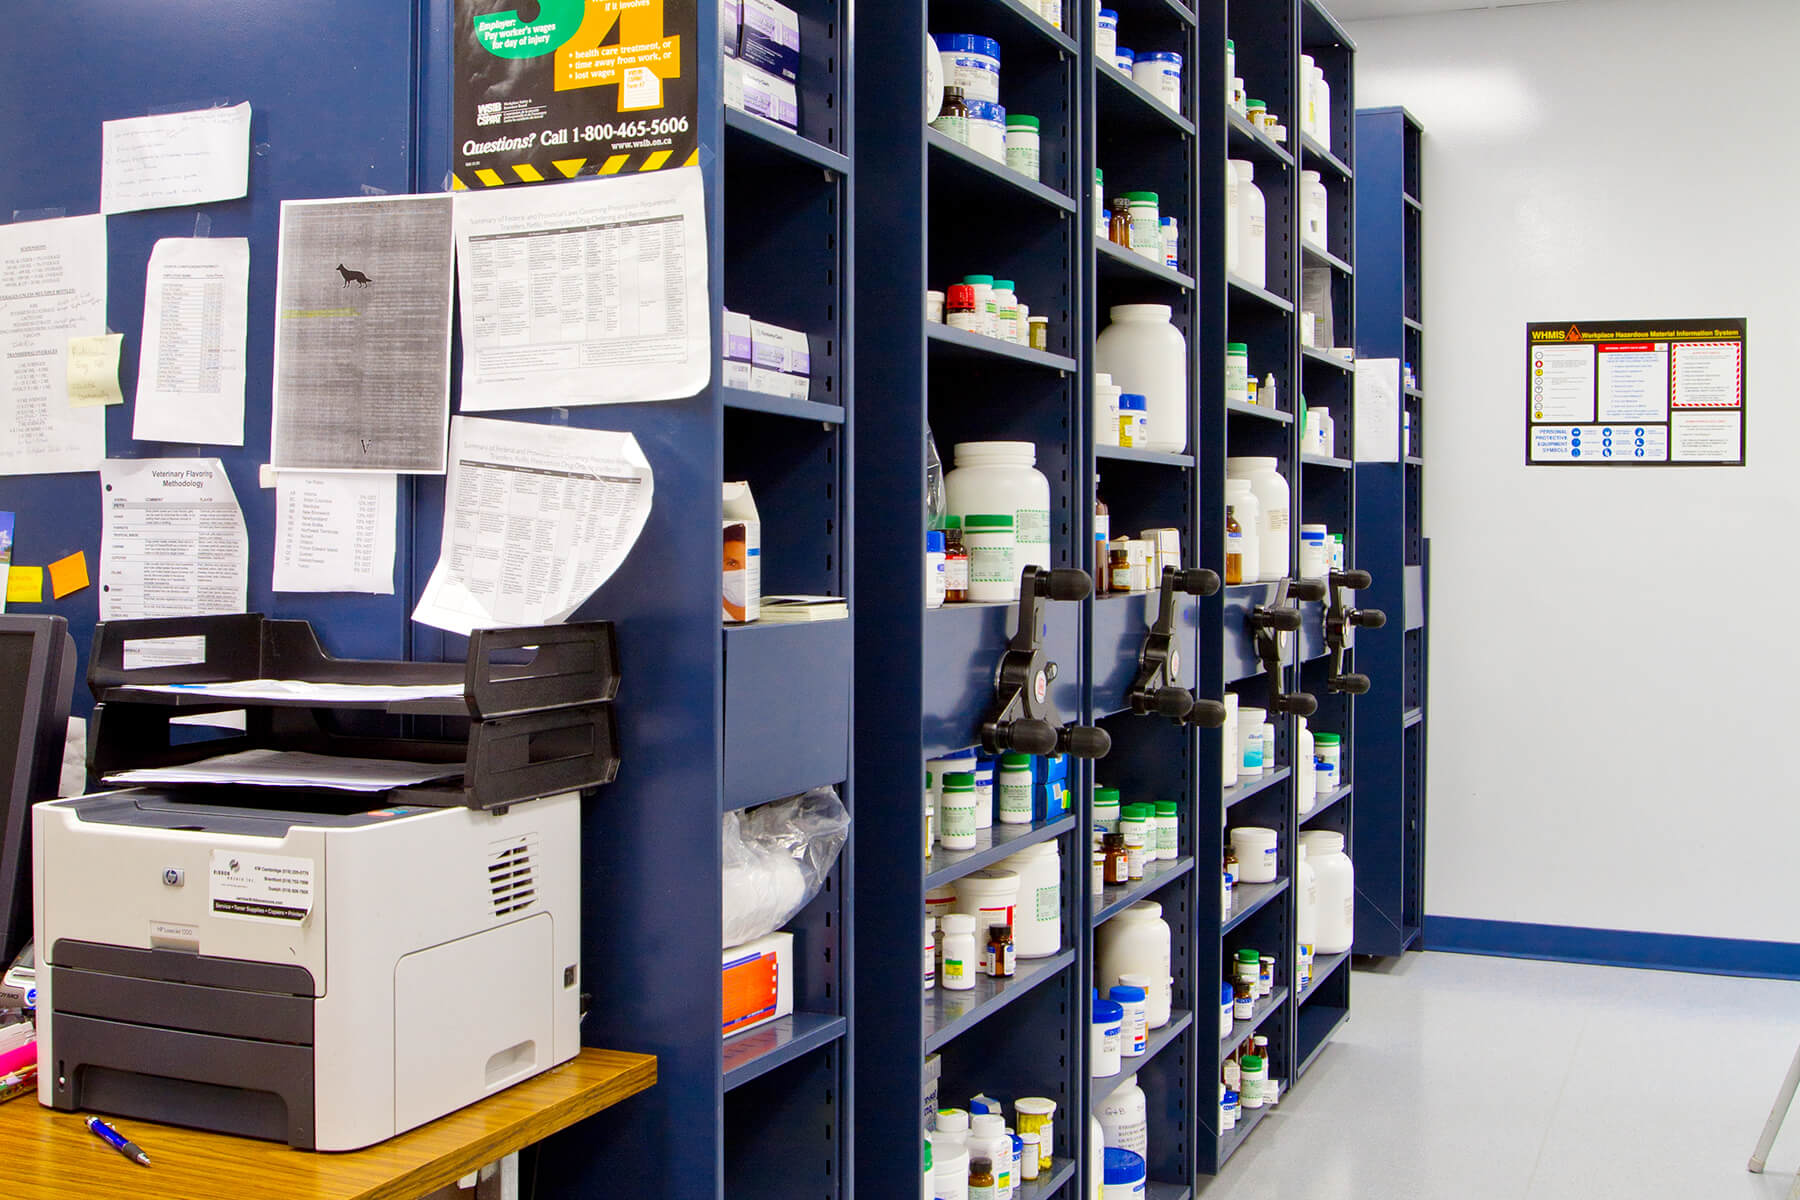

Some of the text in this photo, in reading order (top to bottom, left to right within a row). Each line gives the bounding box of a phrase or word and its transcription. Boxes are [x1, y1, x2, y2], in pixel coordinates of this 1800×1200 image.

[620, 0, 650, 9] involves
[479, 19, 516, 31] Employer:
[485, 24, 556, 41] Pay worker's wages
[492, 34, 550, 50] for day of injury
[575, 49, 599, 59] health
[601, 48, 618, 56] care
[621, 42, 661, 54] treatment,
[575, 61, 592, 69] time
[594, 58, 615, 67] away
[617, 56, 636, 65] from
[638, 53, 661, 62] work,
[575, 71, 589, 80] lost
[591, 69, 615, 79] wages
[478, 102, 502, 113] WSIB
[463, 116, 689, 156] Questions? Call 1-800-465-5606
[611, 137, 672, 150] www.wsib.on.ca
[1531, 330, 1565, 340] WHMIS
[1676, 329, 1713, 337] Information
[1714, 328, 1739, 337] System
[152, 470, 213, 479] Veterinary Flavoring
[163, 480, 203, 488] Methodology
